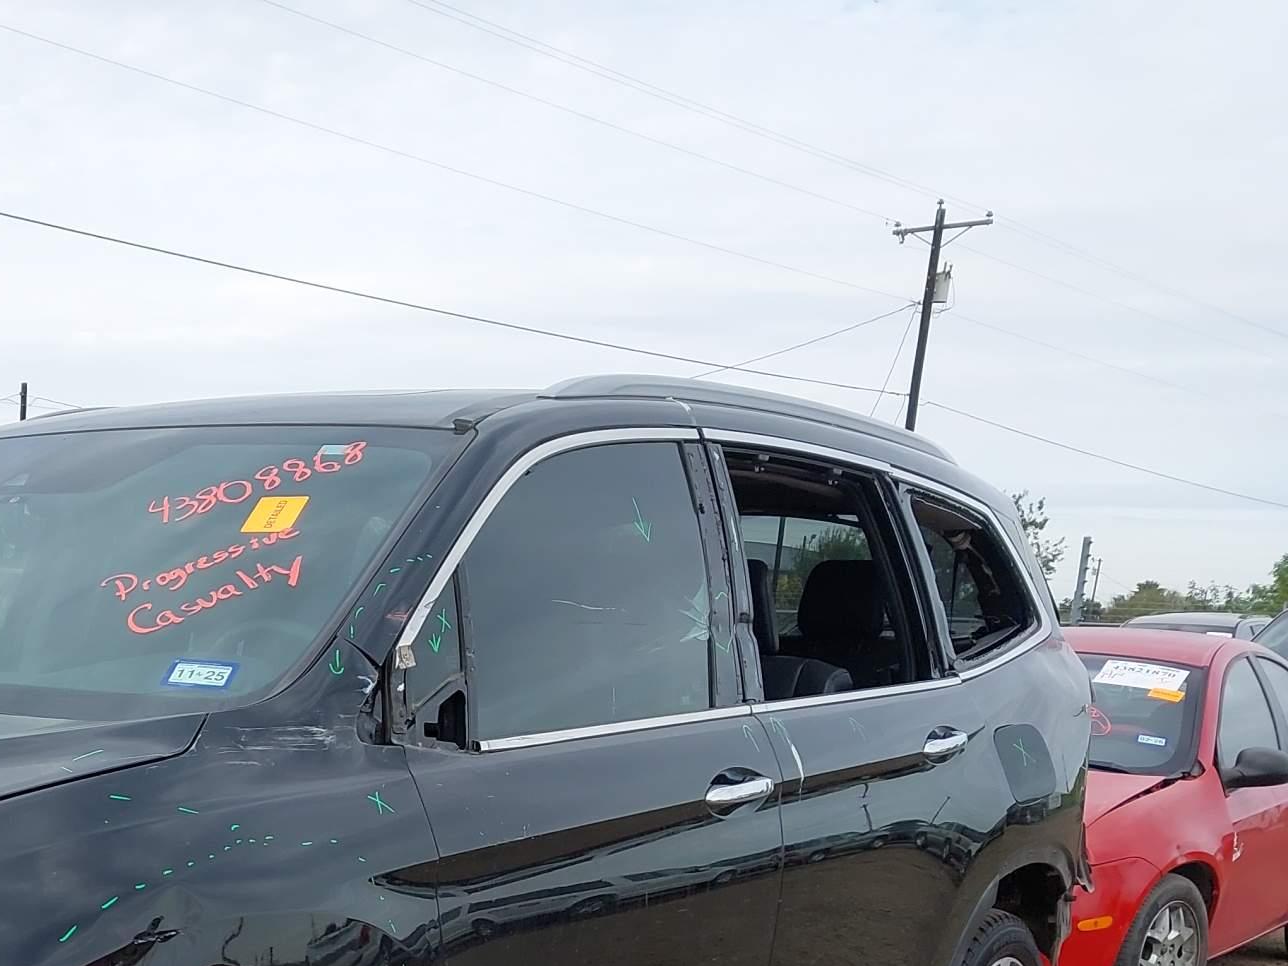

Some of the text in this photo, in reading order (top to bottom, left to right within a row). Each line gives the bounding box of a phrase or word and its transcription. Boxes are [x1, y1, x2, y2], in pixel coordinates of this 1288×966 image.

[148, 441, 367, 523] 43808868
[100, 528, 300, 601] Progressive
[127, 556, 303, 634] Casualty
